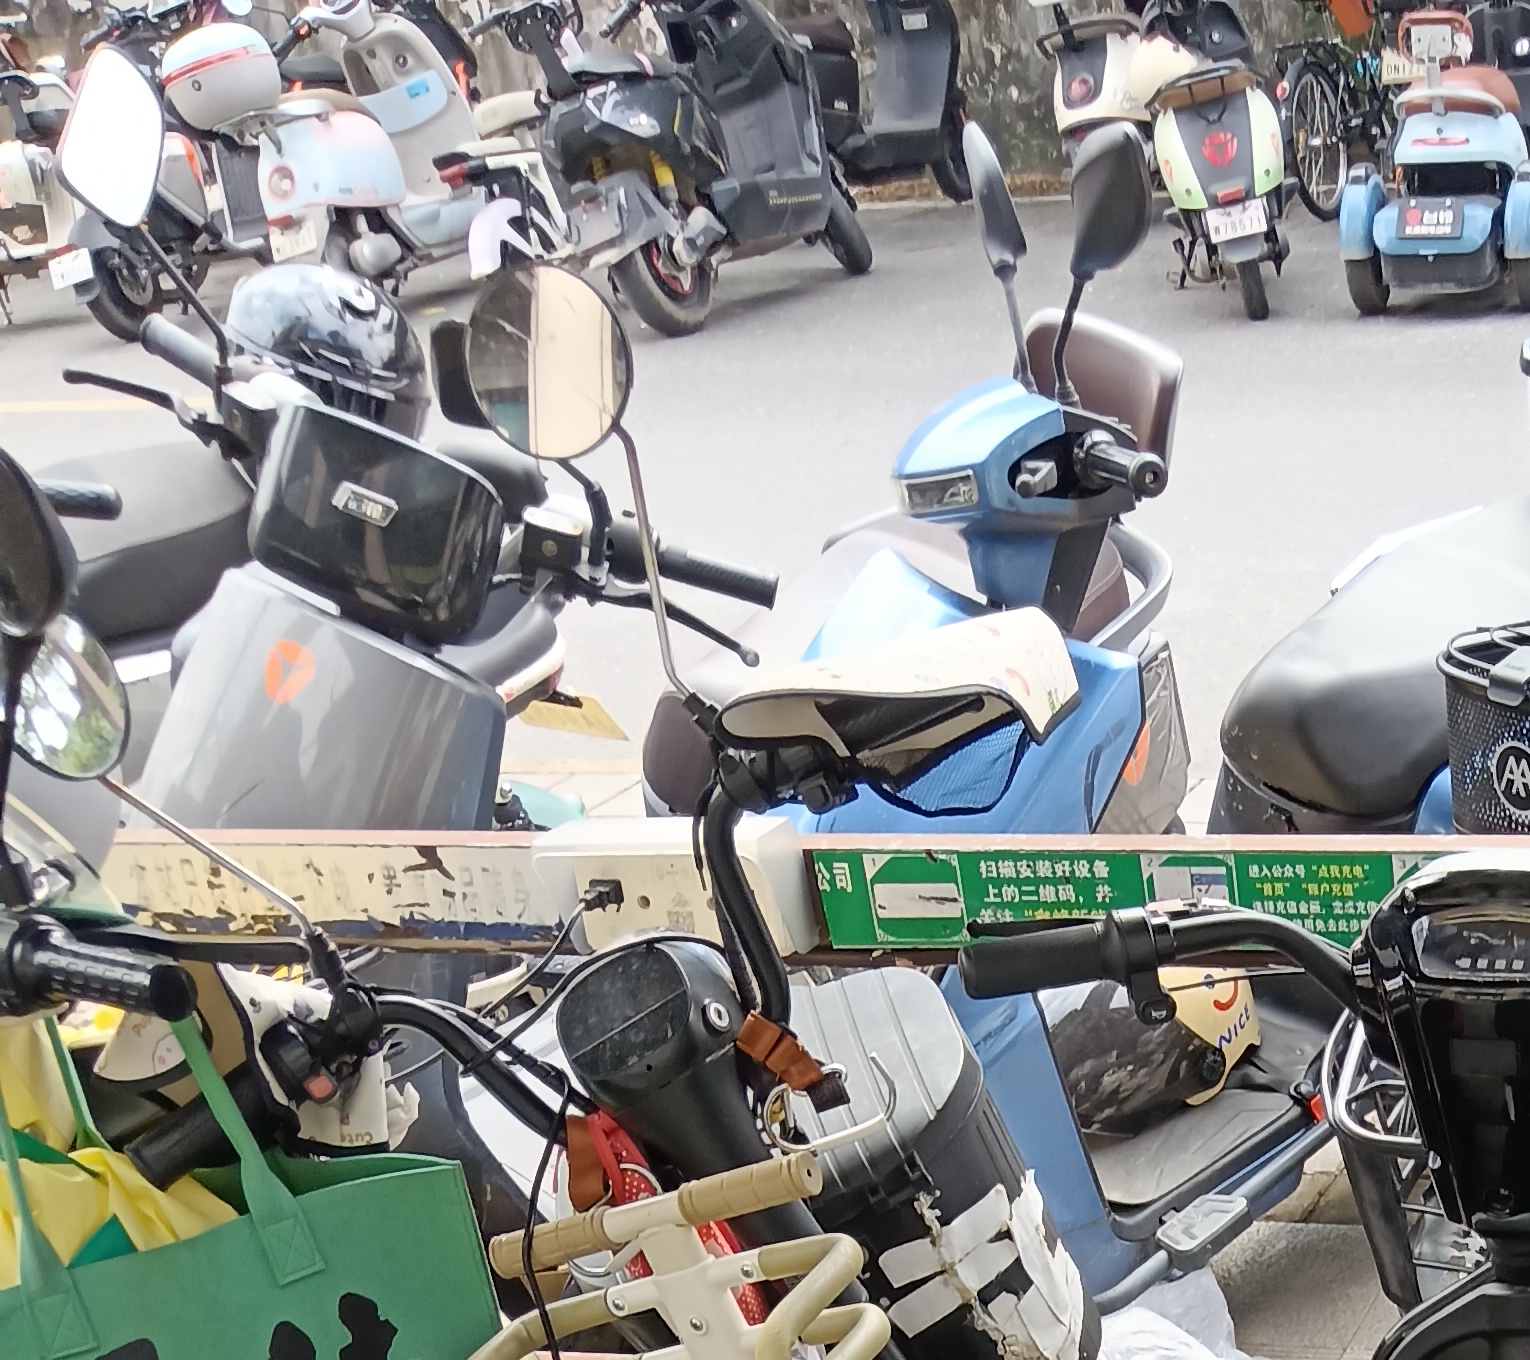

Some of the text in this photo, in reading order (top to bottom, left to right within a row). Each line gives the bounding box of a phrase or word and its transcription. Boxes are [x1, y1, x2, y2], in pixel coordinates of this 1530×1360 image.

[979, 859, 1110, 879] 扫描安装好设备
[1217, 1001, 1252, 1050] NICE
